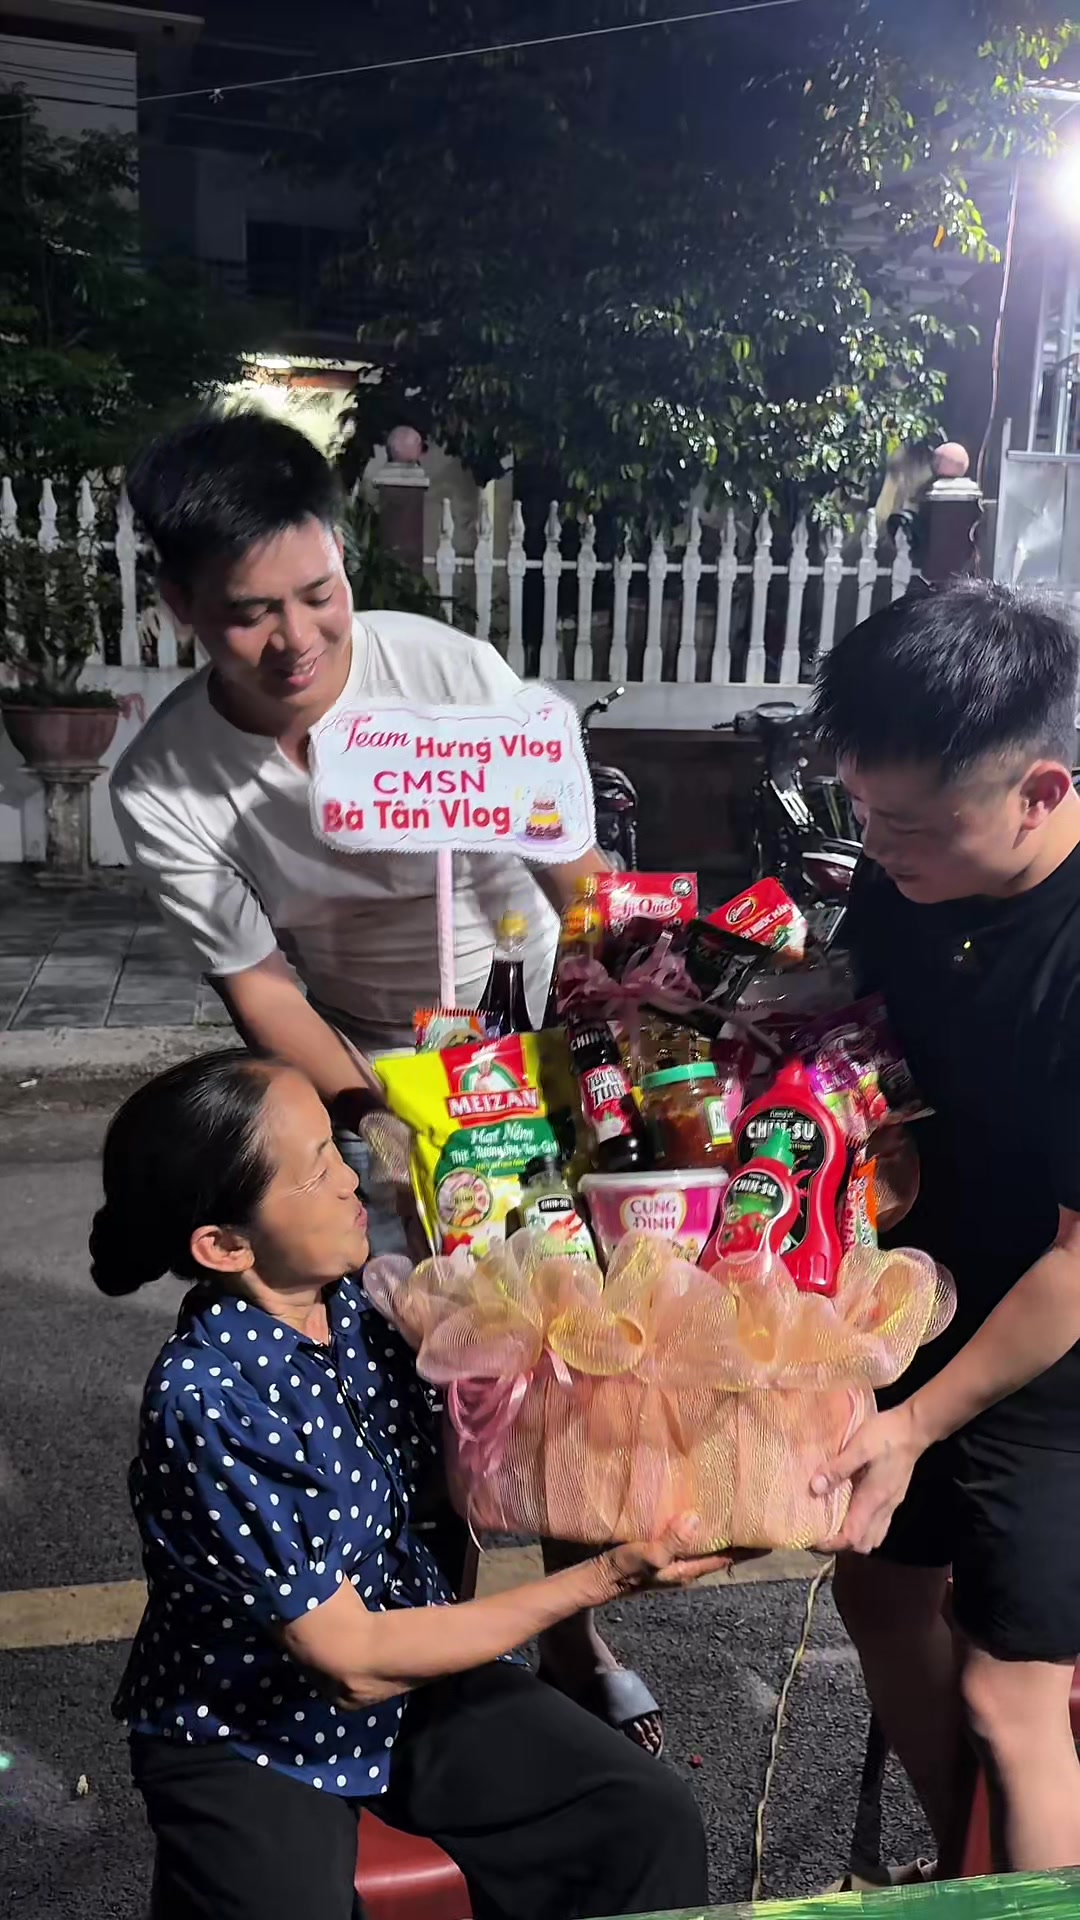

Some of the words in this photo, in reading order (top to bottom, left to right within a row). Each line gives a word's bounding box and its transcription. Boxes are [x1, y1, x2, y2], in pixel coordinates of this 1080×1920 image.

[336, 712, 411, 754] Team
[415, 736, 492, 763] Hưng
[500, 734, 562, 763] Vlog
[373, 769, 485, 795] CMSN
[323, 799, 364, 832] Bà
[439, 798, 511, 835] Vlog
[448, 1089, 537, 1117] MEIZAN
[630, 1199, 677, 1215] CUNG
